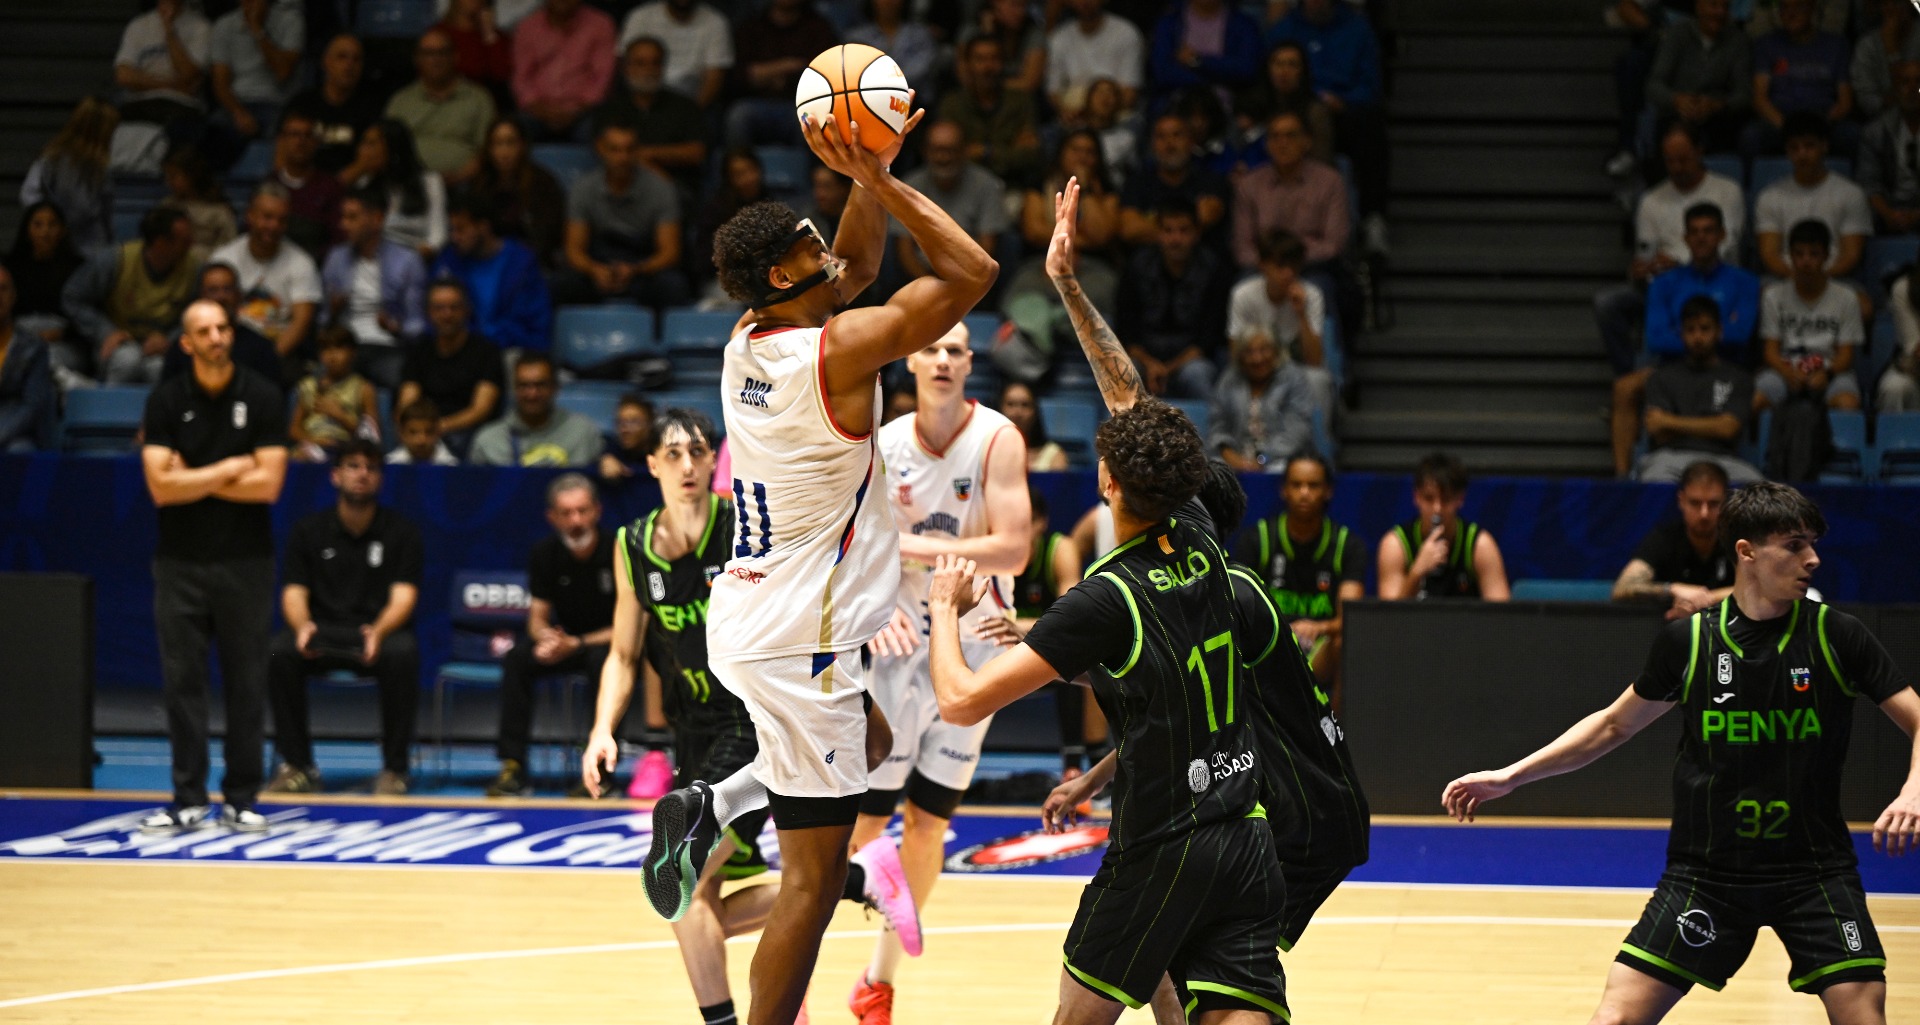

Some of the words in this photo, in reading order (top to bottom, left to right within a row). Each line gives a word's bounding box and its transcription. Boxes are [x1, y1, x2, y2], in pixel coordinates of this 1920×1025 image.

[733, 478, 772, 559] 11
[1148, 546, 1211, 594] SALÓ
[683, 667, 711, 704] 11
[1187, 630, 1235, 734] 17
[1790, 667, 1811, 675] LIGA
[1702, 707, 1823, 744] PENYA
[1735, 799, 1791, 839] 32
[1676, 915, 1717, 942] NISSAN
